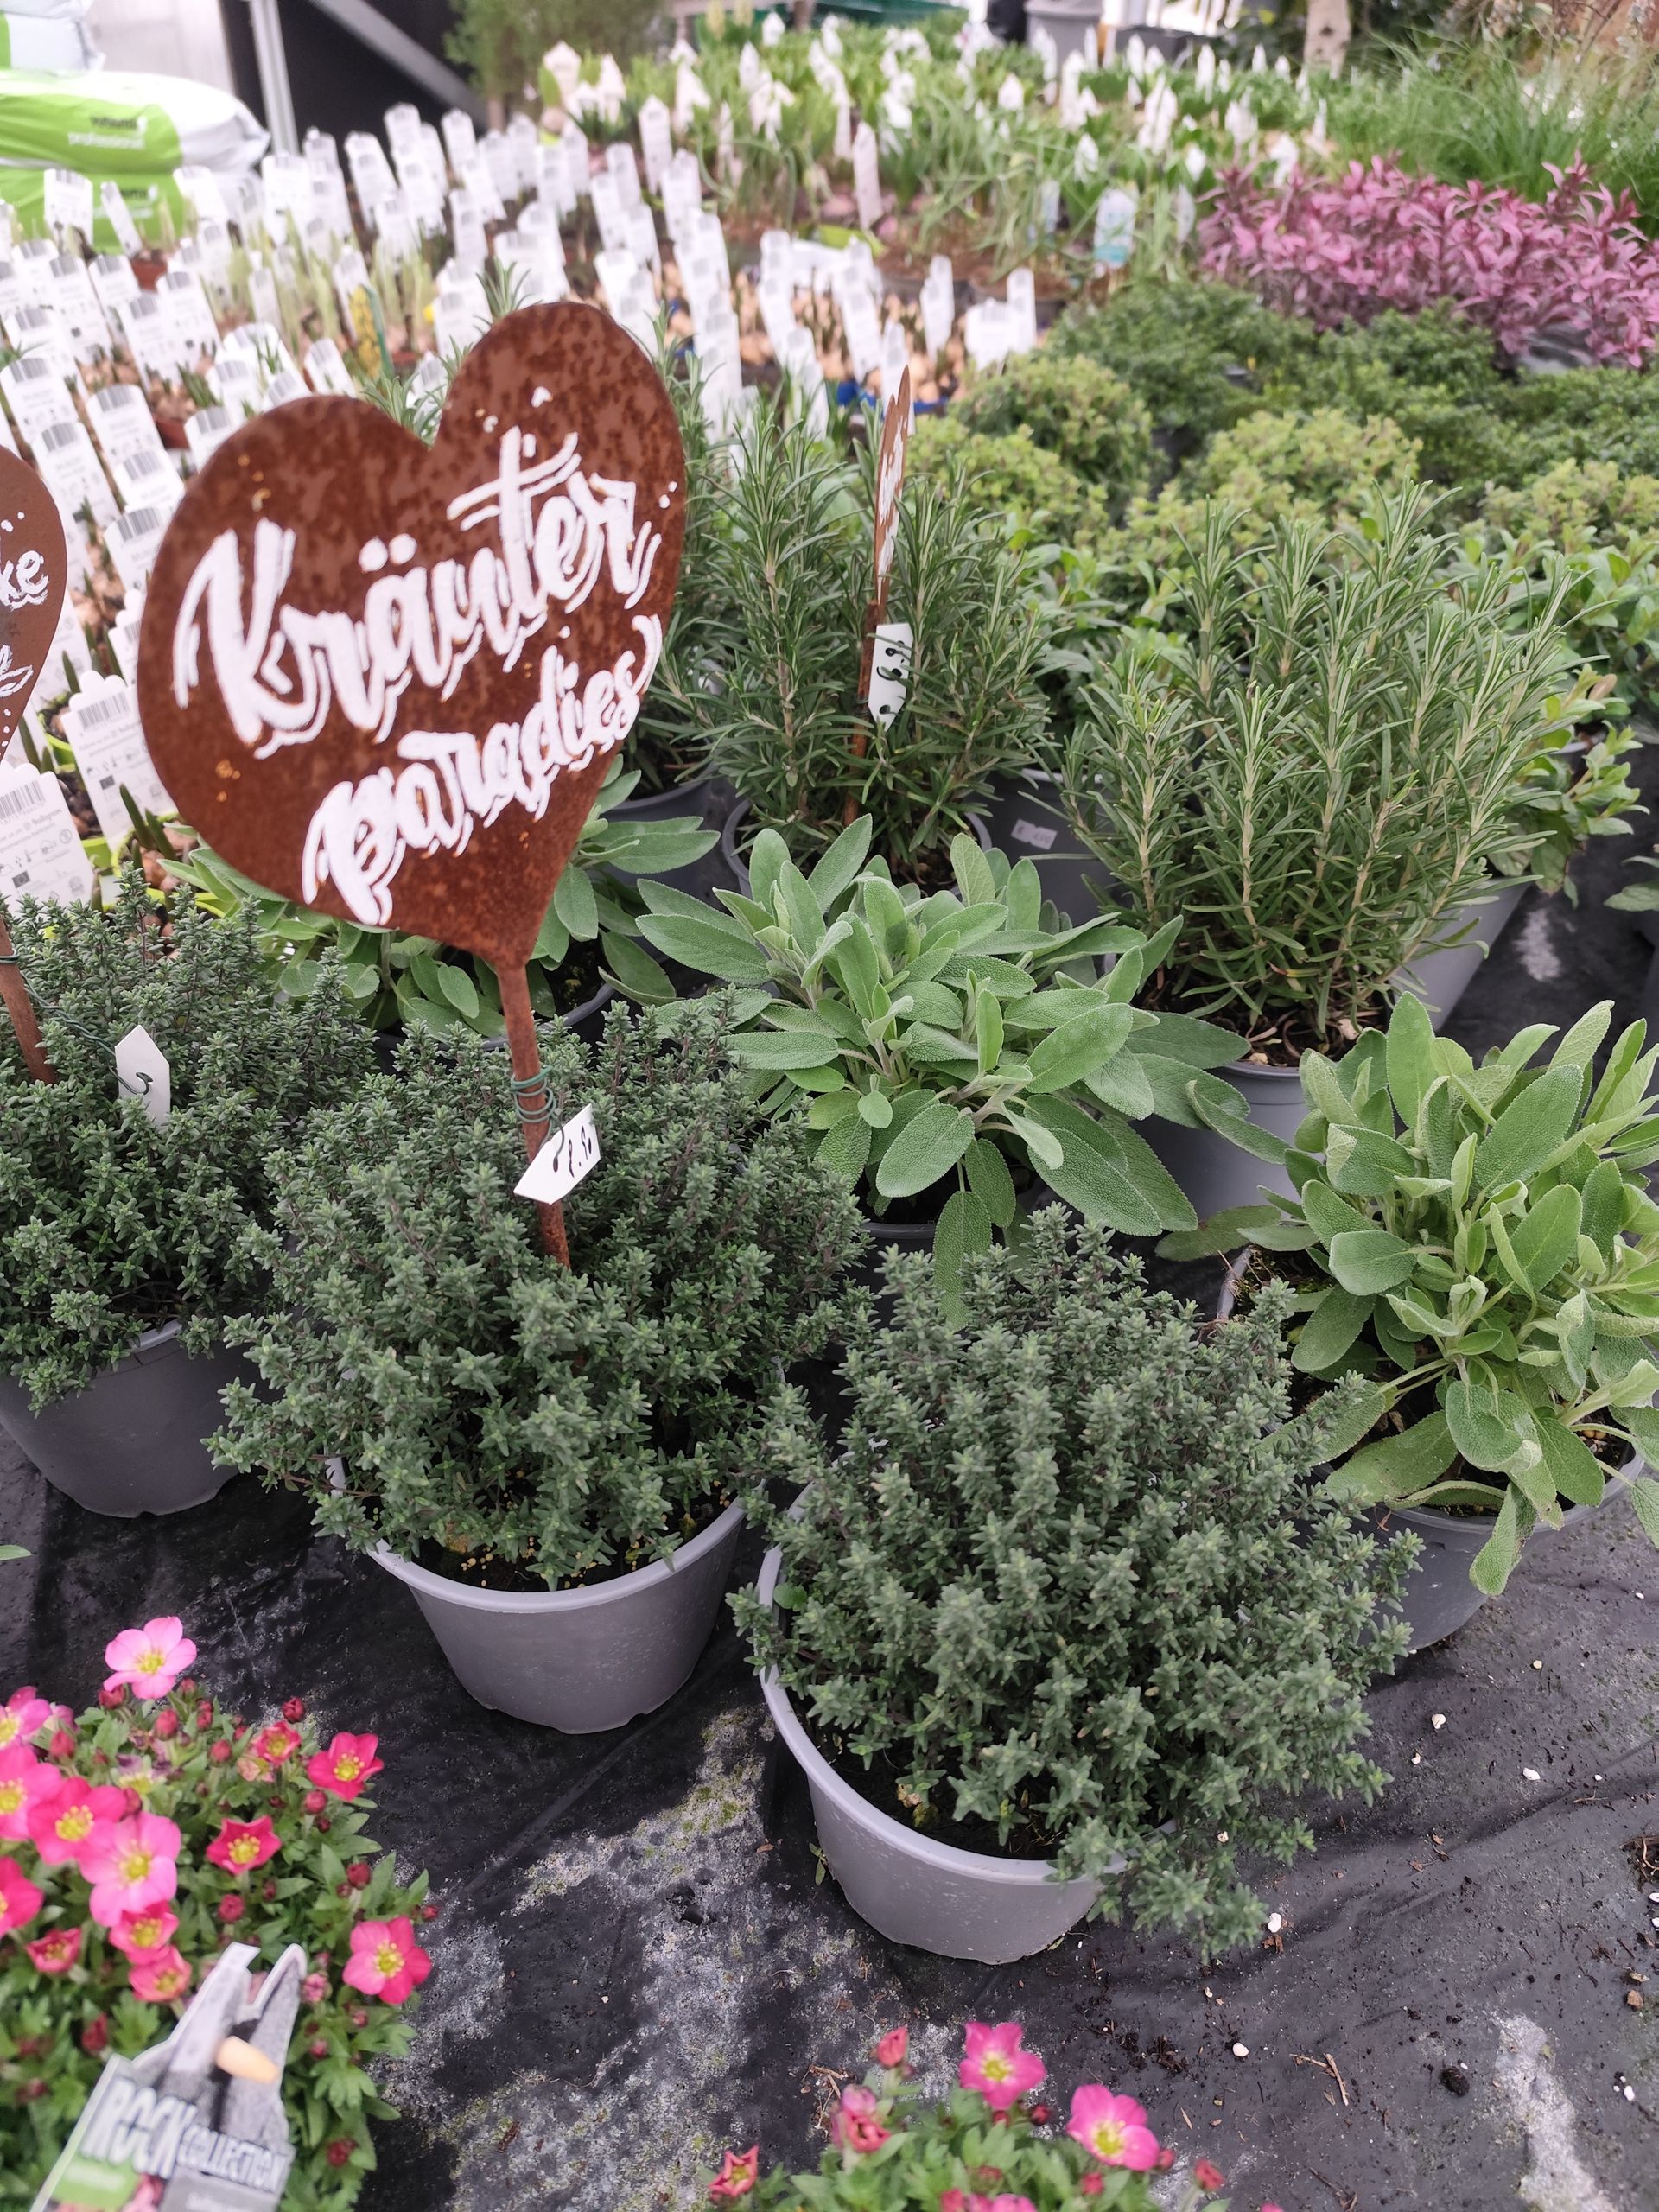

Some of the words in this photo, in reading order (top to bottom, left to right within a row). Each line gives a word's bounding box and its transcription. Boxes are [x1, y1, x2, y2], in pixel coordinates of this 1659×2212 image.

[175, 426, 662, 760] Kräuter
[81, 2077, 197, 2178] ROCK
[175, 2124, 288, 2193] COLLECTION
